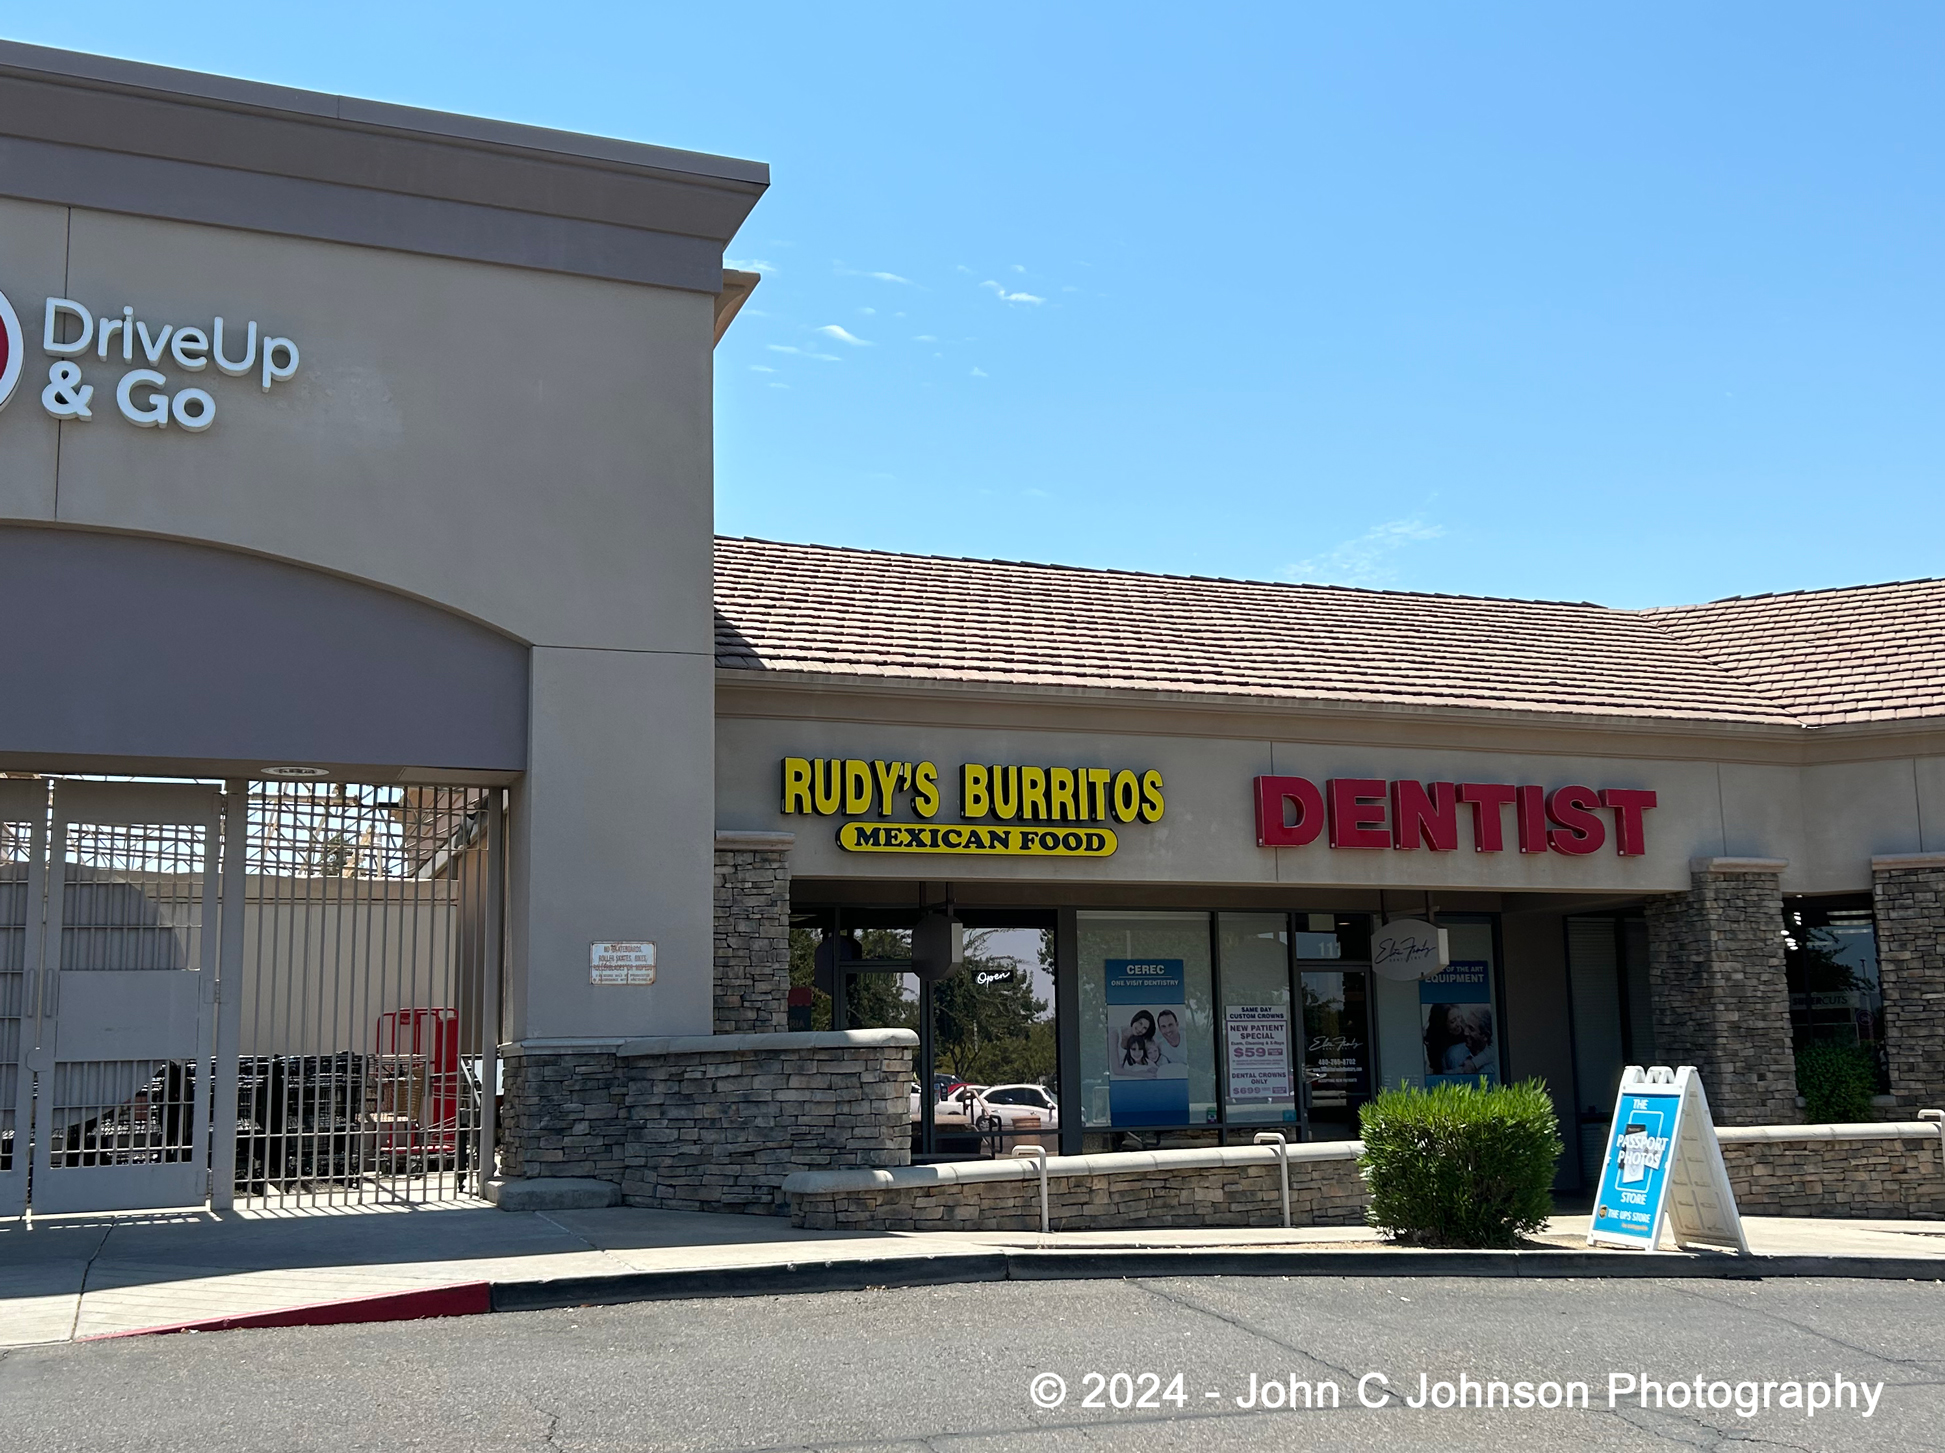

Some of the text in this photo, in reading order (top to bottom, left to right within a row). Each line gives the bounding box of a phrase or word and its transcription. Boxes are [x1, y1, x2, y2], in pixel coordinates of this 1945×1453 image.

[43, 297, 300, 393] DriveUp
[41, 360, 216, 432] & Go
[780, 756, 1165, 824] RUDY'S BURRITOS
[1253, 775, 1657, 856] DENTIST
[854, 826, 1106, 852] MEXICAN FOOD
[1126, 964, 1165, 975] CEREC
[977, 972, 1010, 989] Open
[1111, 979, 1179, 987] ONE VISIT DENTISTRY
[1425, 974, 1485, 983] EQUIPMENT
[1792, 995, 1848, 1006] SUERCUTS
[1230, 1024, 1284, 1032] NEW PATIENT
[1233, 1047, 1266, 1058] $59
[1633, 1099, 1649, 1110] THE
[1616, 1134, 1669, 1151] PASSPORT
[1617, 1150, 1660, 1166] PHOTOS
[1620, 1192, 1648, 1206] STORE
[1608, 1209, 1652, 1224] THE UPS STORE
